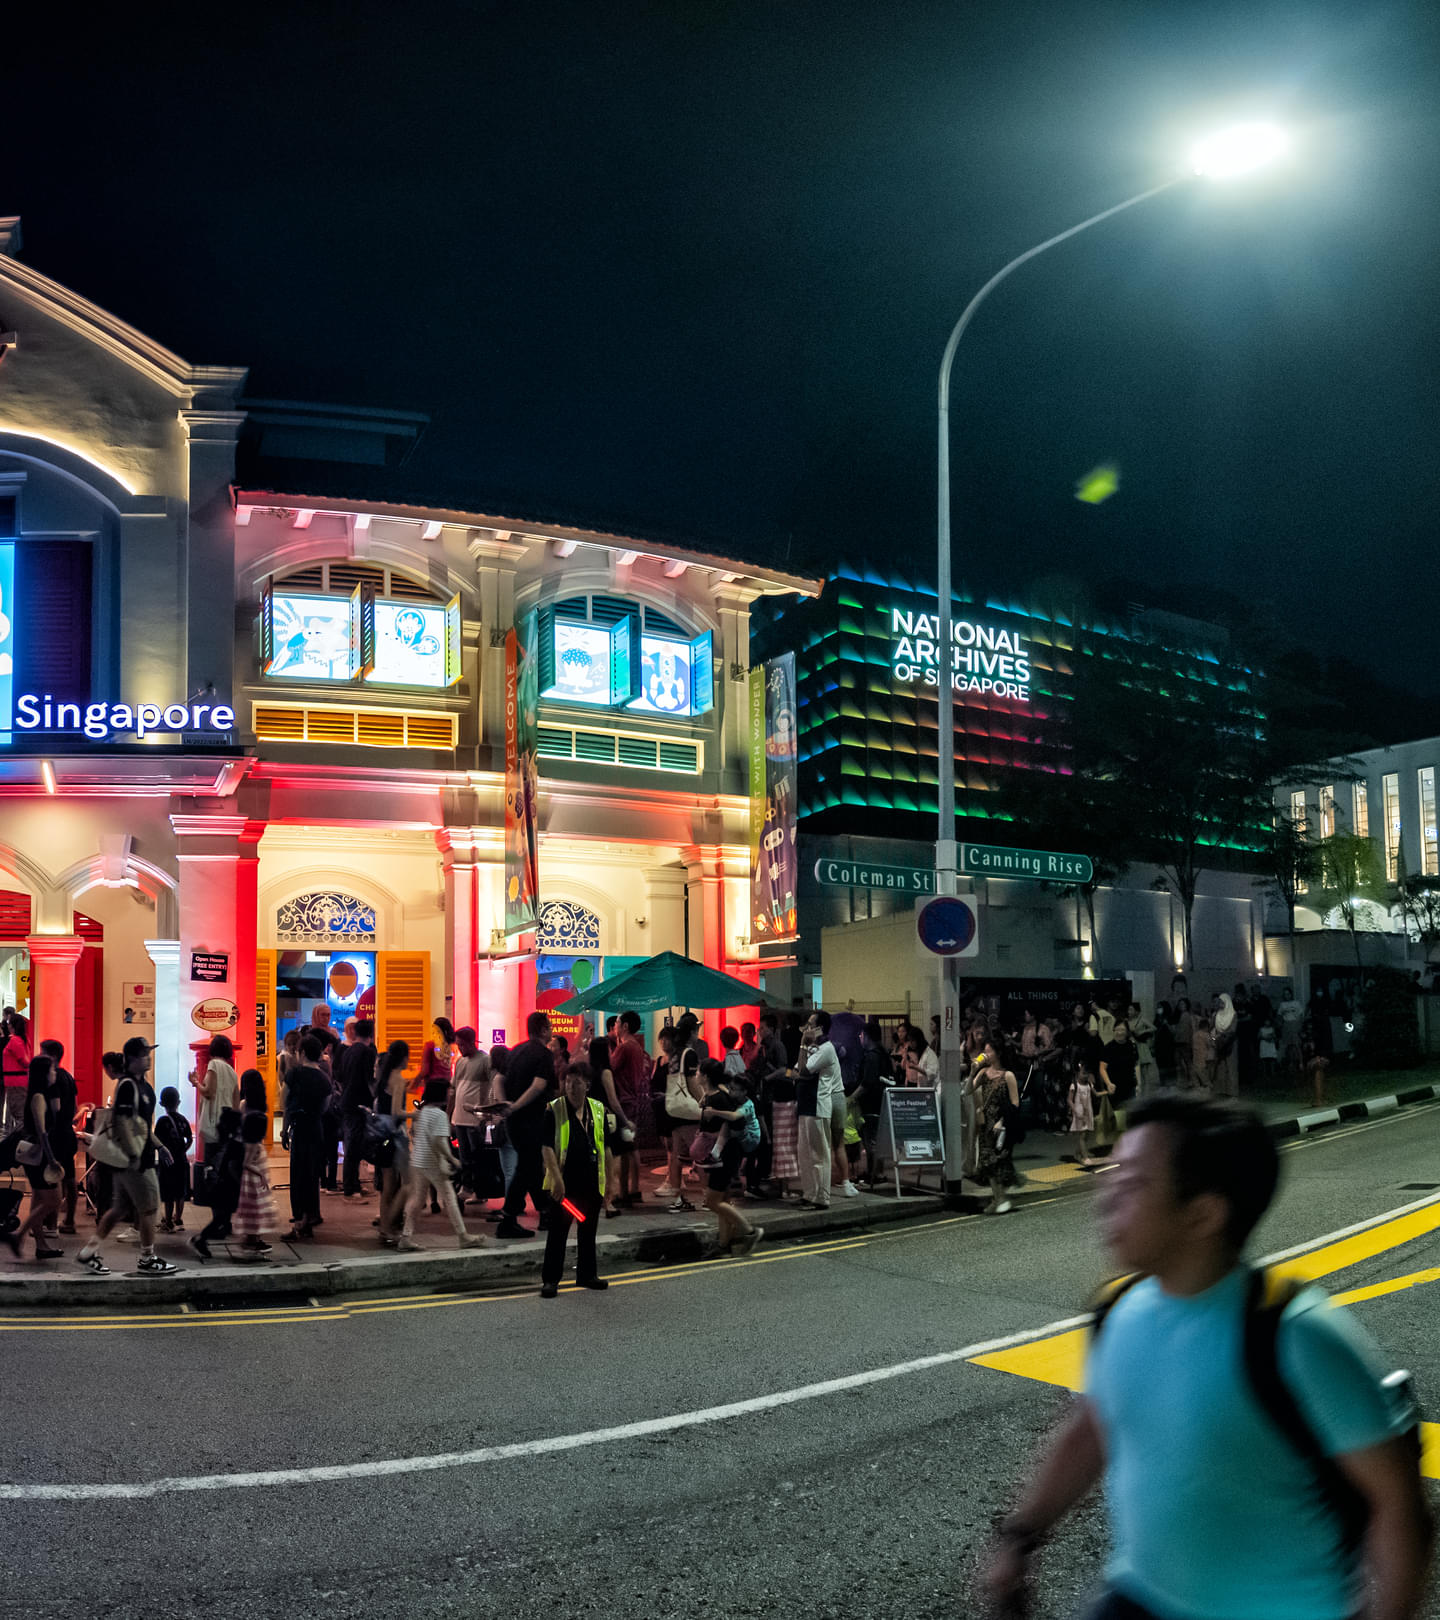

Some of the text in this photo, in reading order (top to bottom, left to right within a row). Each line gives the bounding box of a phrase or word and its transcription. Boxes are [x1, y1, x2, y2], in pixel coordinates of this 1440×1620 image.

[892, 608, 1028, 657] NATIONAL
[894, 663, 921, 682] OF
[15, 694, 235, 739] Singapore
[969, 848, 1083, 875] Canning Rise
[827, 863, 930, 890] Coleman St
[1008, 992, 1058, 1000] ALL THINGS
